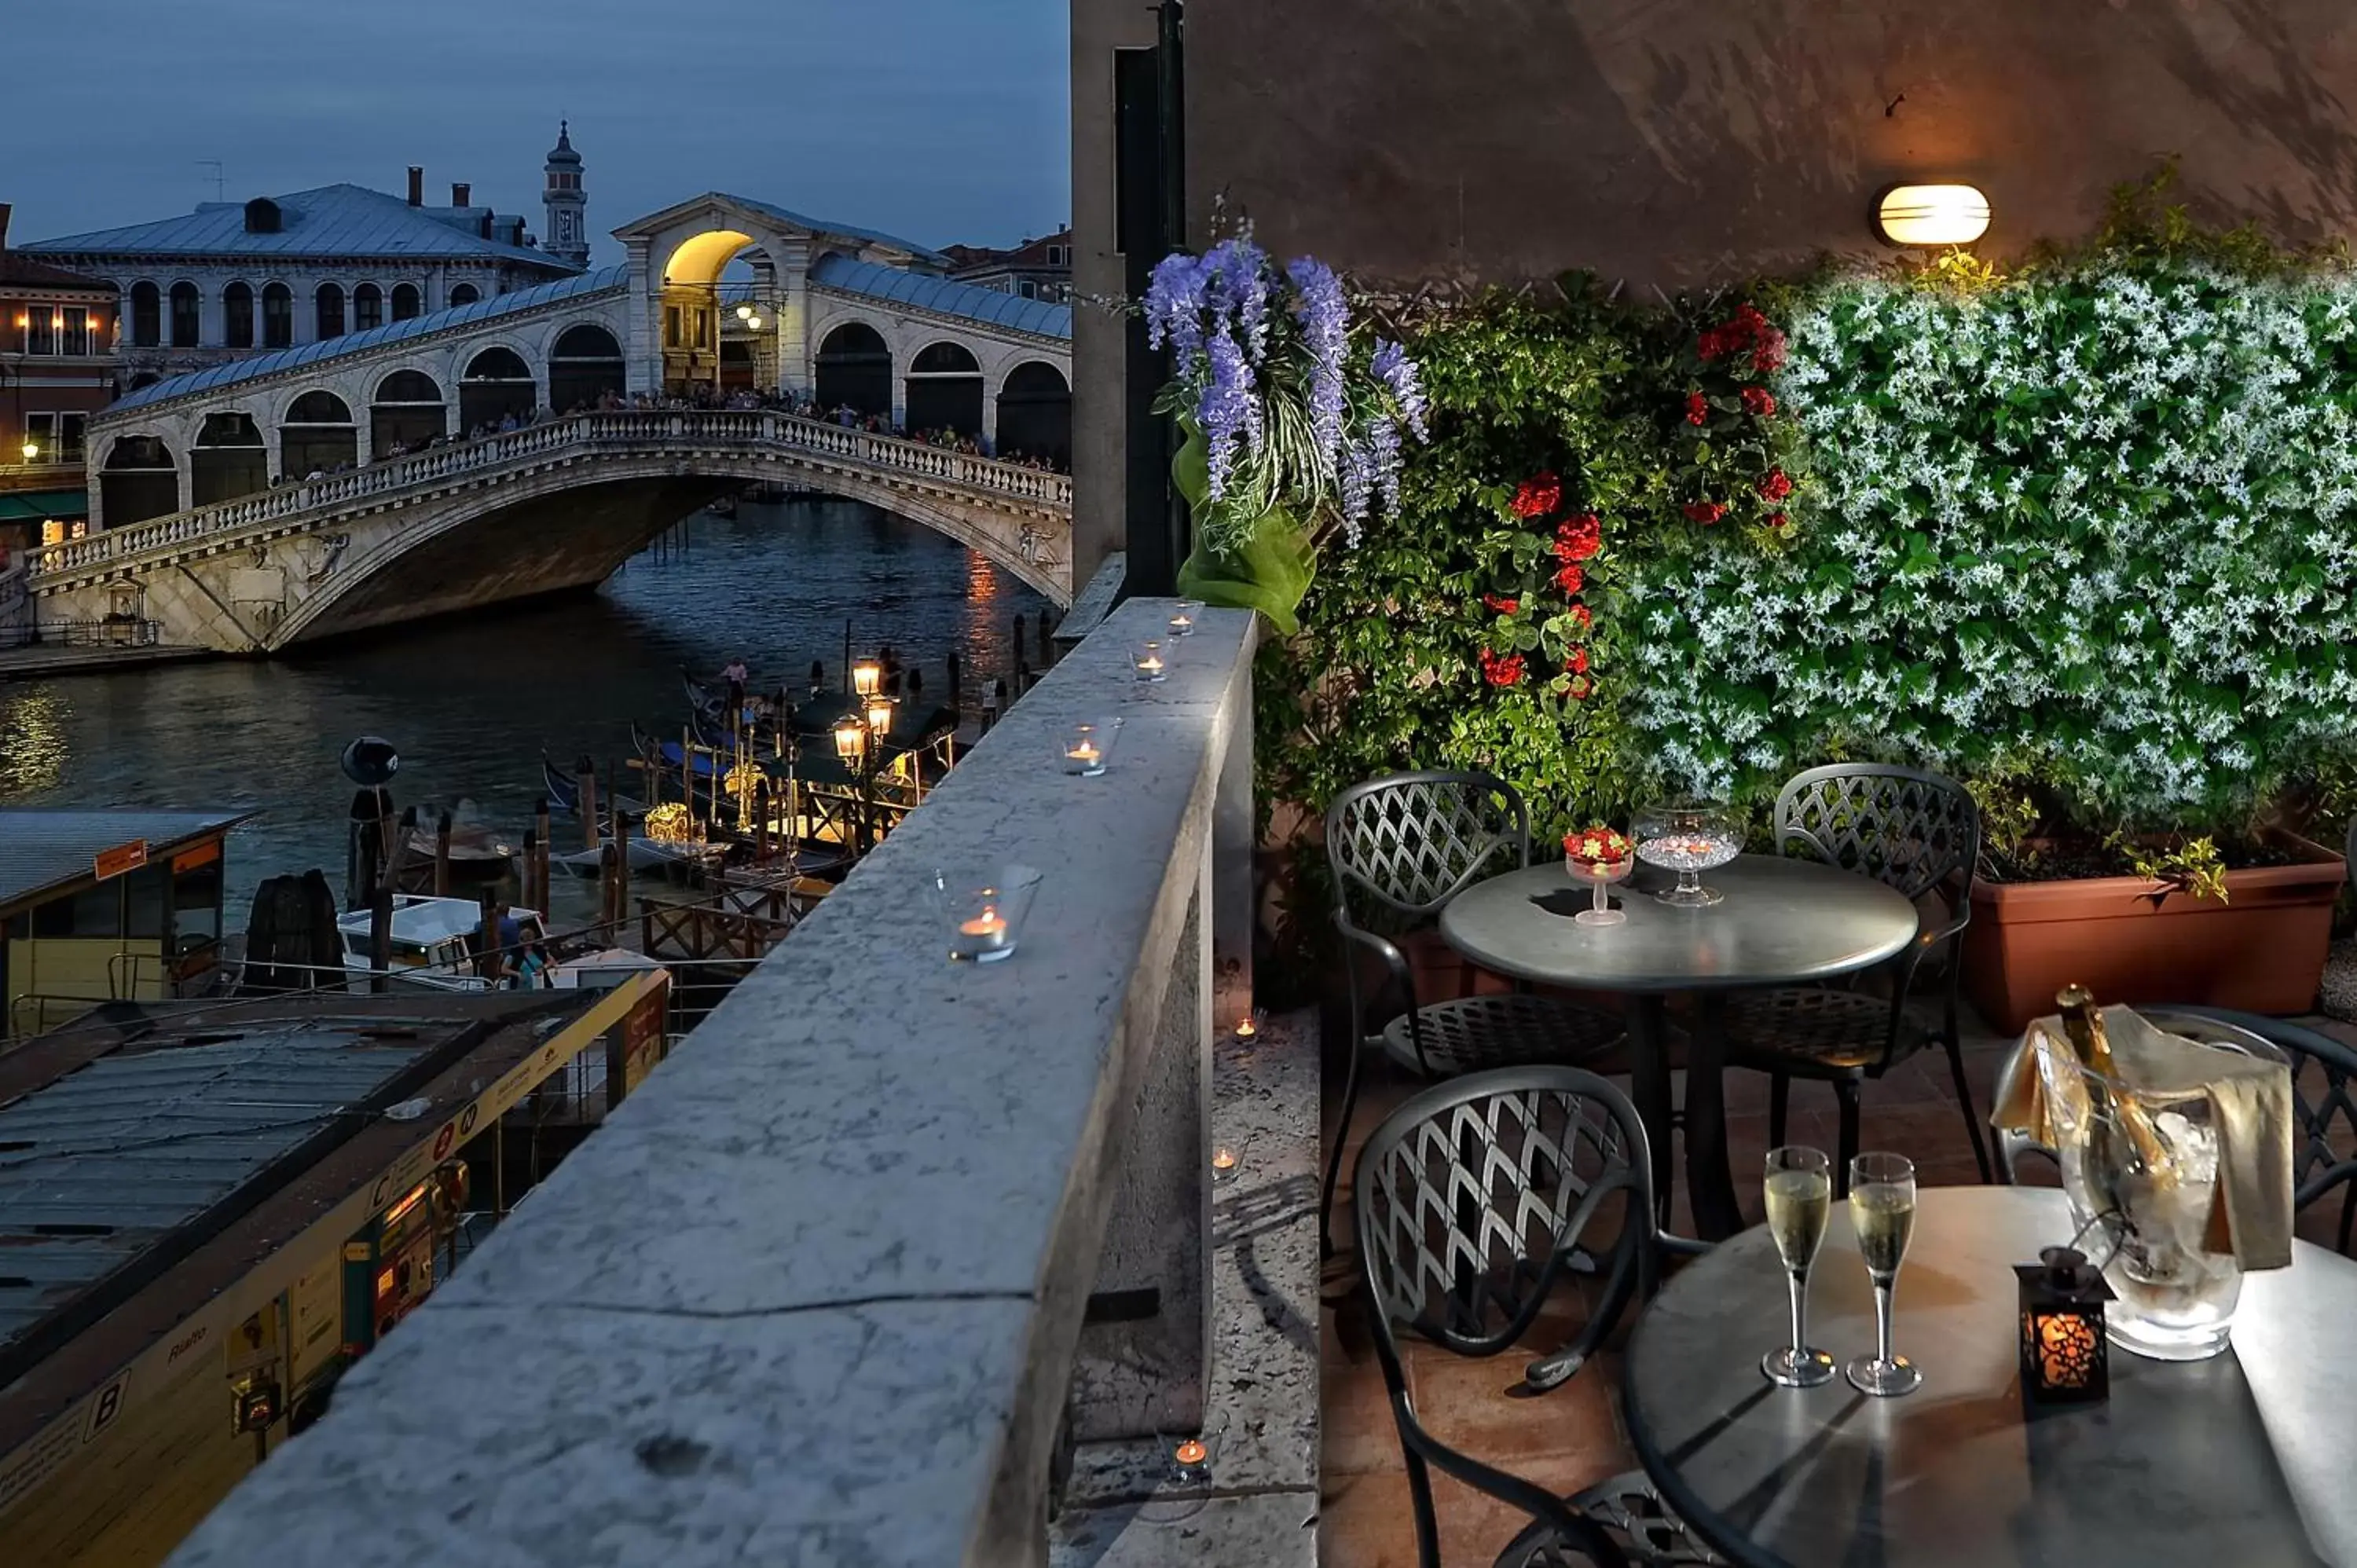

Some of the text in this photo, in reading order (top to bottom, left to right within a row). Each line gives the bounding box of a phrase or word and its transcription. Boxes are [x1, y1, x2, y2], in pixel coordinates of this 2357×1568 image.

[374, 1175, 390, 1207] C
[167, 1327, 207, 1365] Rialto
[93, 1384, 120, 1431] B
